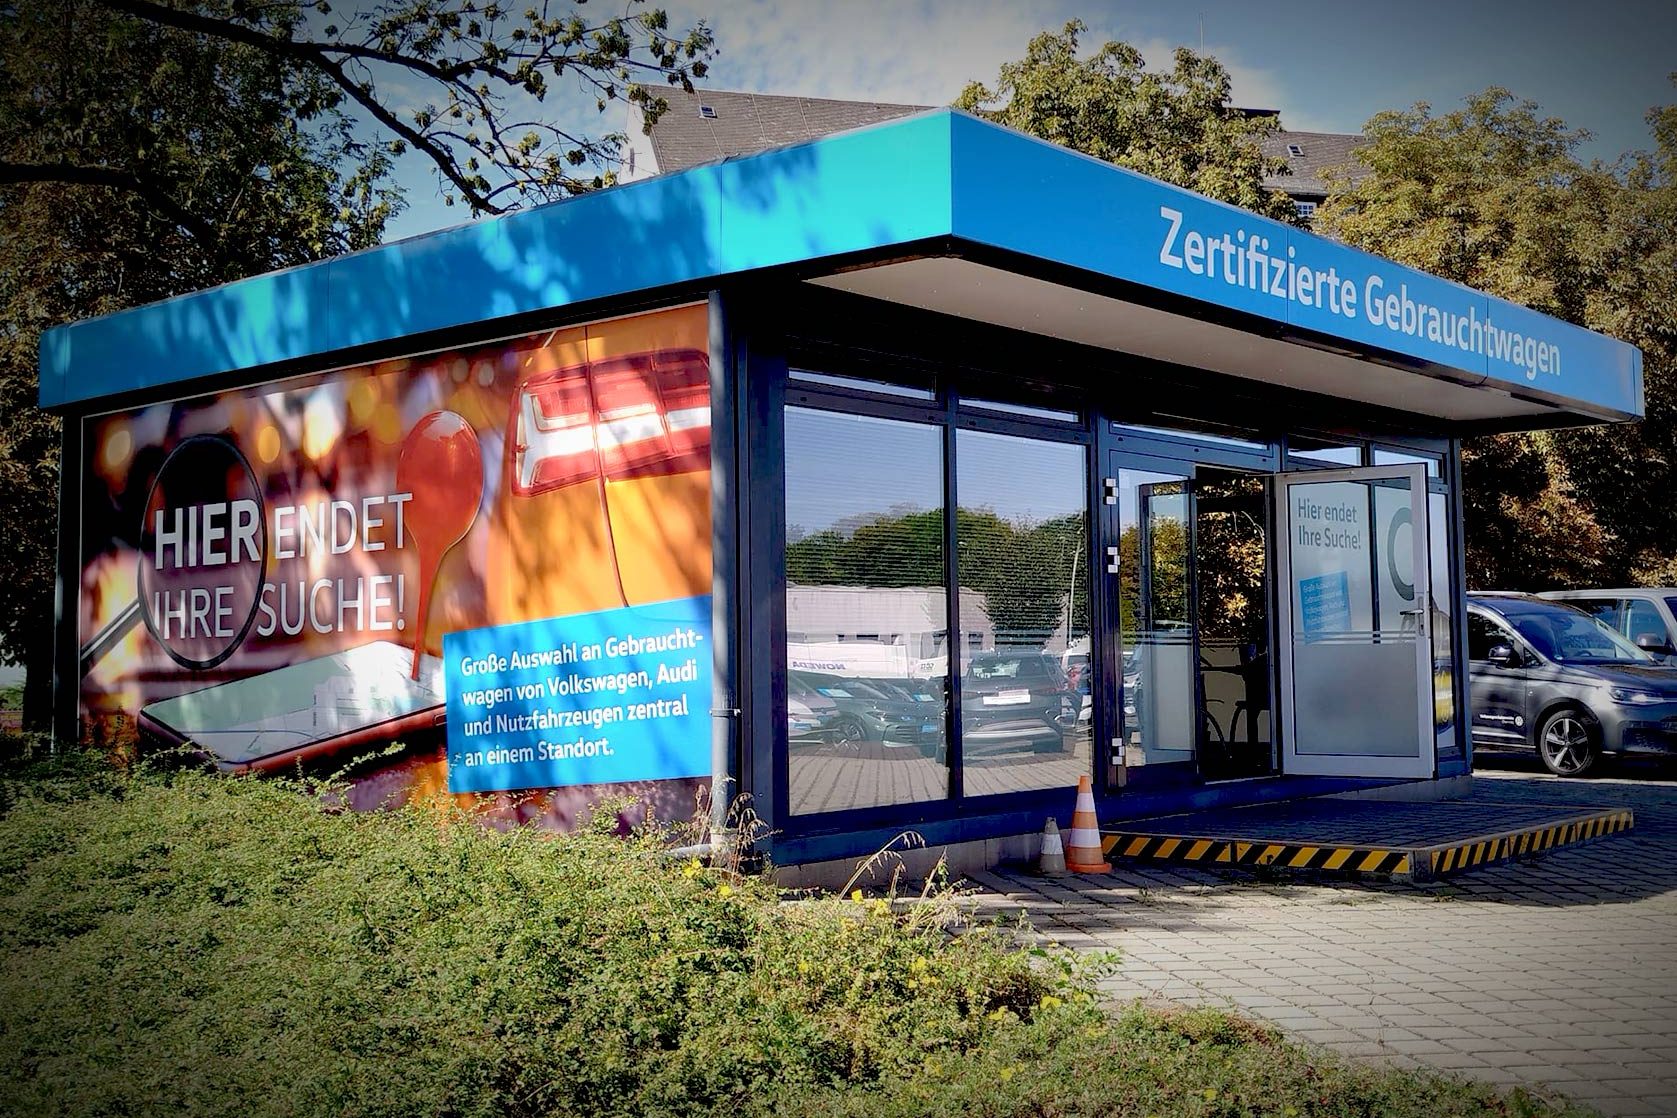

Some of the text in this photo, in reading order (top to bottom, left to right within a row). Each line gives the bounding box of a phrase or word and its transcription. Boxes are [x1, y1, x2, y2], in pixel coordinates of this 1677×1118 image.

[1159, 205, 1561, 381] Zertifizierte Gebrauchtwagen
[154, 493, 413, 570] HIER ENDET
[1298, 498, 1358, 523] Hier endet
[1299, 525, 1361, 550] Ihre Suche!
[154, 574, 406, 641] IHRE SUCHE!
[461, 628, 704, 677] Große Auswahl an Gebraucht-
[462, 659, 698, 709] wagen von Volkswagen, Audi
[464, 694, 689, 737] und Nutzfahrzeugen zentral
[465, 736, 615, 767] an einem Standort.
